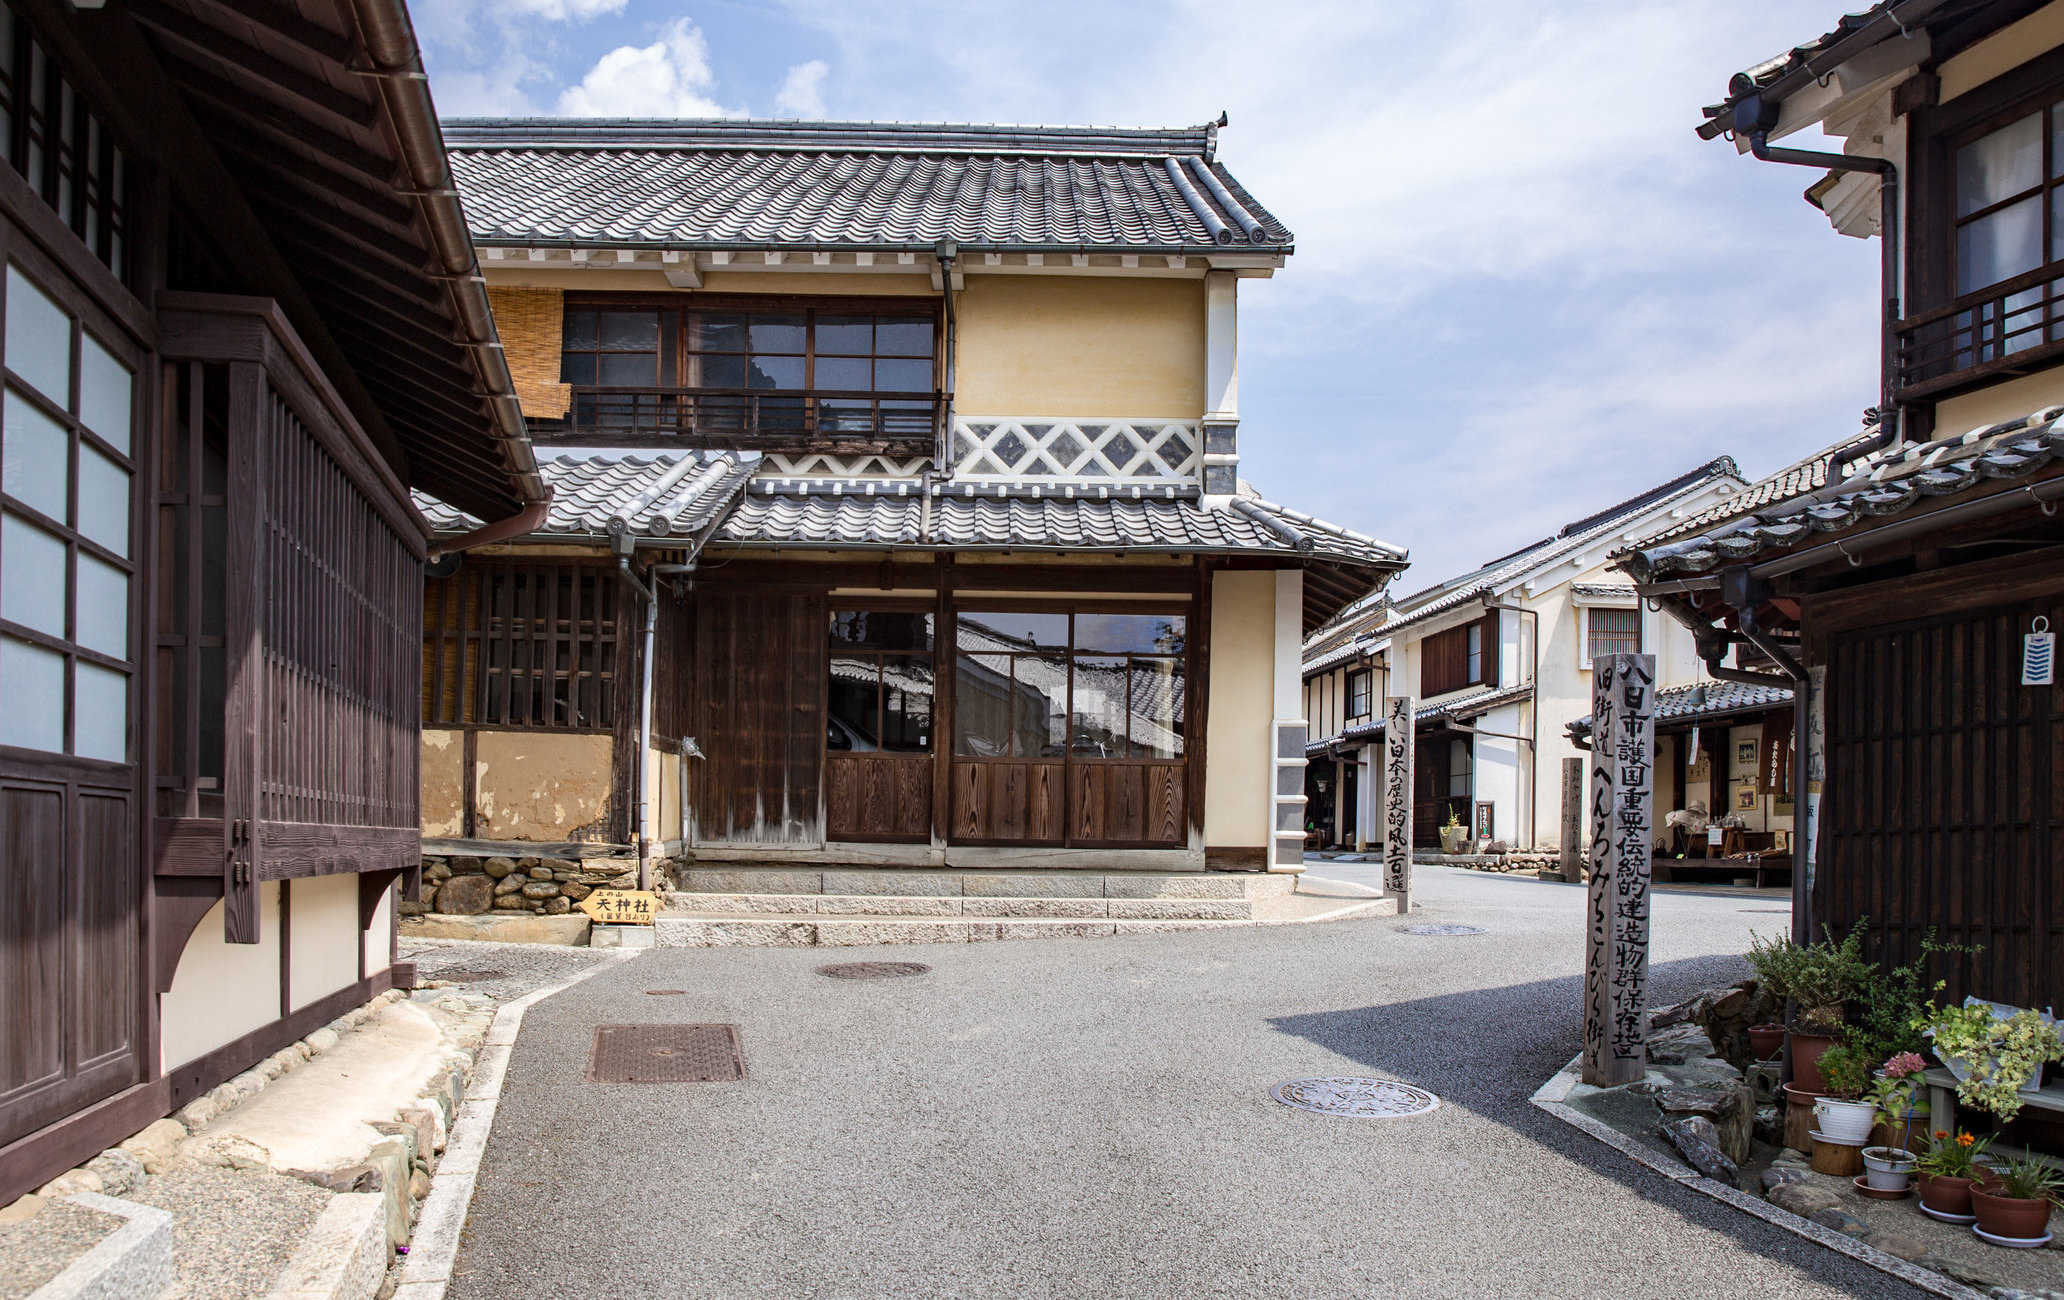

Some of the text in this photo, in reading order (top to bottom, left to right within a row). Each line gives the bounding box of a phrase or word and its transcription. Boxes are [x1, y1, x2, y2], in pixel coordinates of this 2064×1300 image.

[1385, 699, 1408, 893] 美しい日本の歴史的風土百選
[1611, 666, 1653, 1060] 八日市護国重要伝統的建造物群保存地区
[596, 898, 649, 913] 天神社
